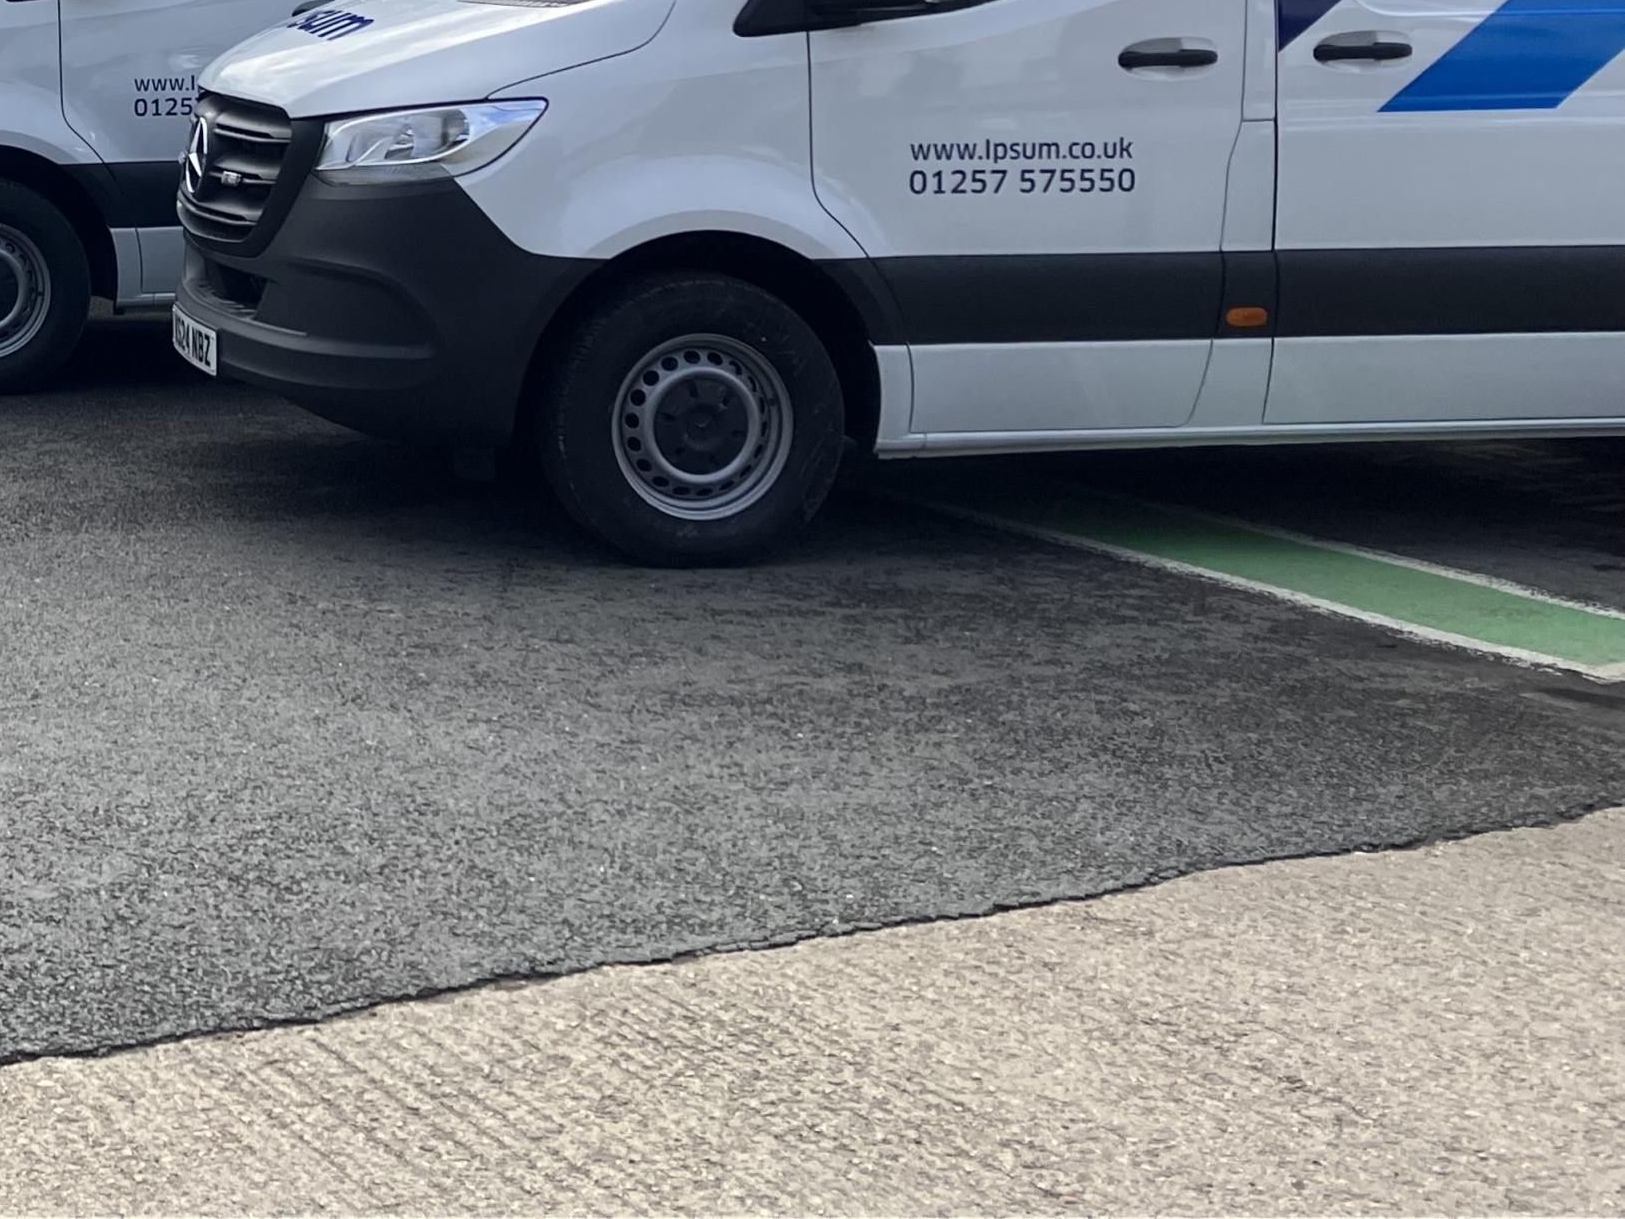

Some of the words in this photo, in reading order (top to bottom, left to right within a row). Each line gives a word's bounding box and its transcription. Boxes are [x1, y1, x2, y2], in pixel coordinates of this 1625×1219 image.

[910, 137, 1134, 163] www.Ipsum.co.uk
[909, 170, 1007, 194] 01257
[1020, 168, 1135, 193] 575550
